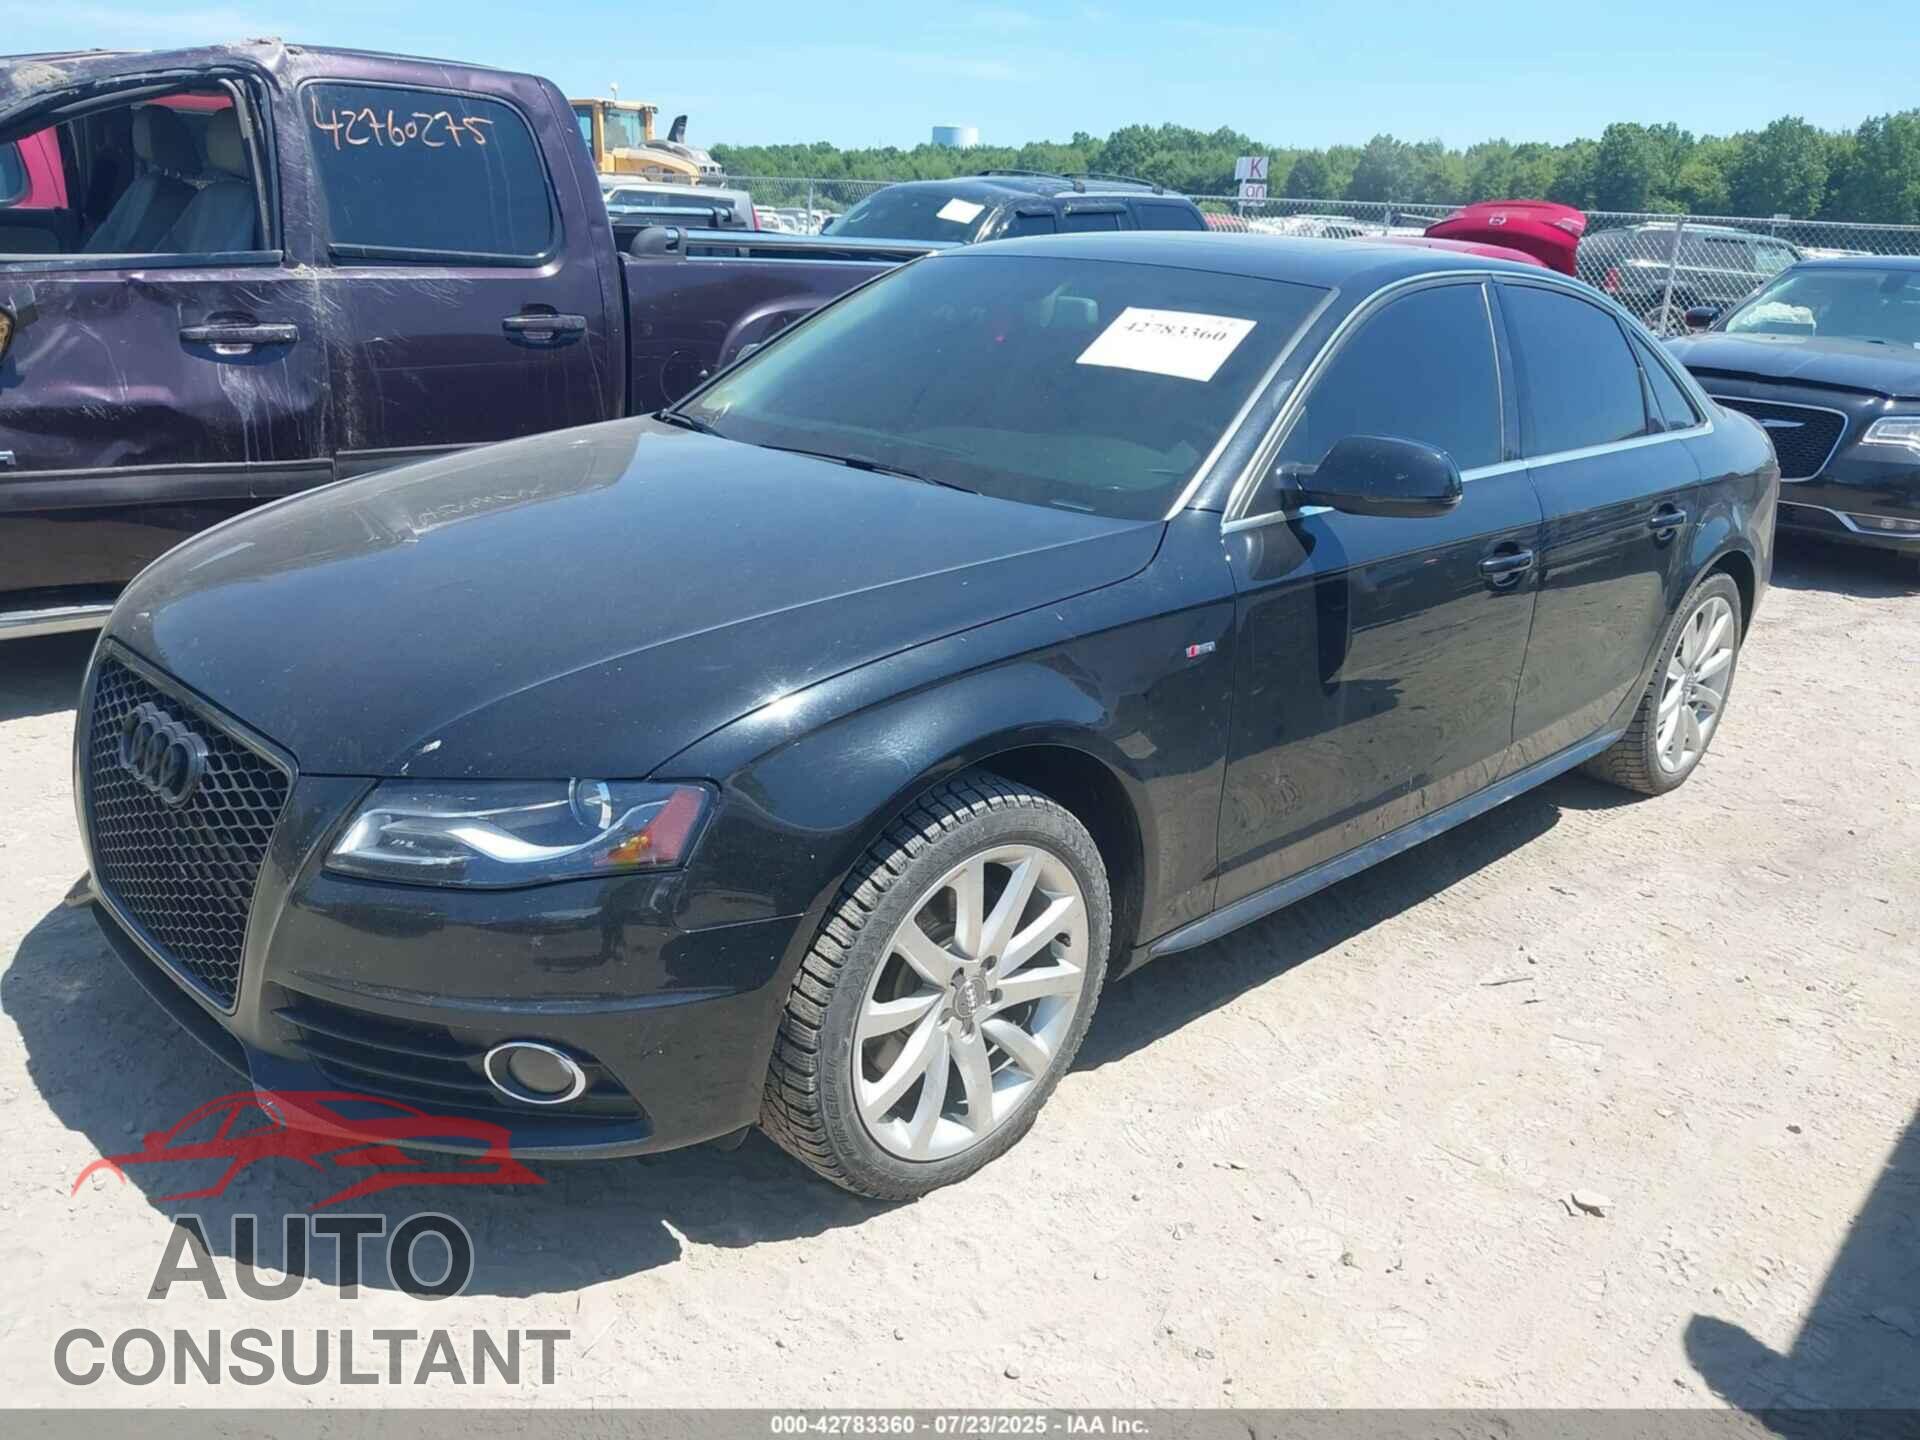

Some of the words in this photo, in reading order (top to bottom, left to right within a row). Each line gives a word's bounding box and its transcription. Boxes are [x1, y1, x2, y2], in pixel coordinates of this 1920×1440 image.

[311, 95, 495, 151] 42760275
[1249, 157, 1264, 178] K
[1122, 320, 1228, 342] 42783360
